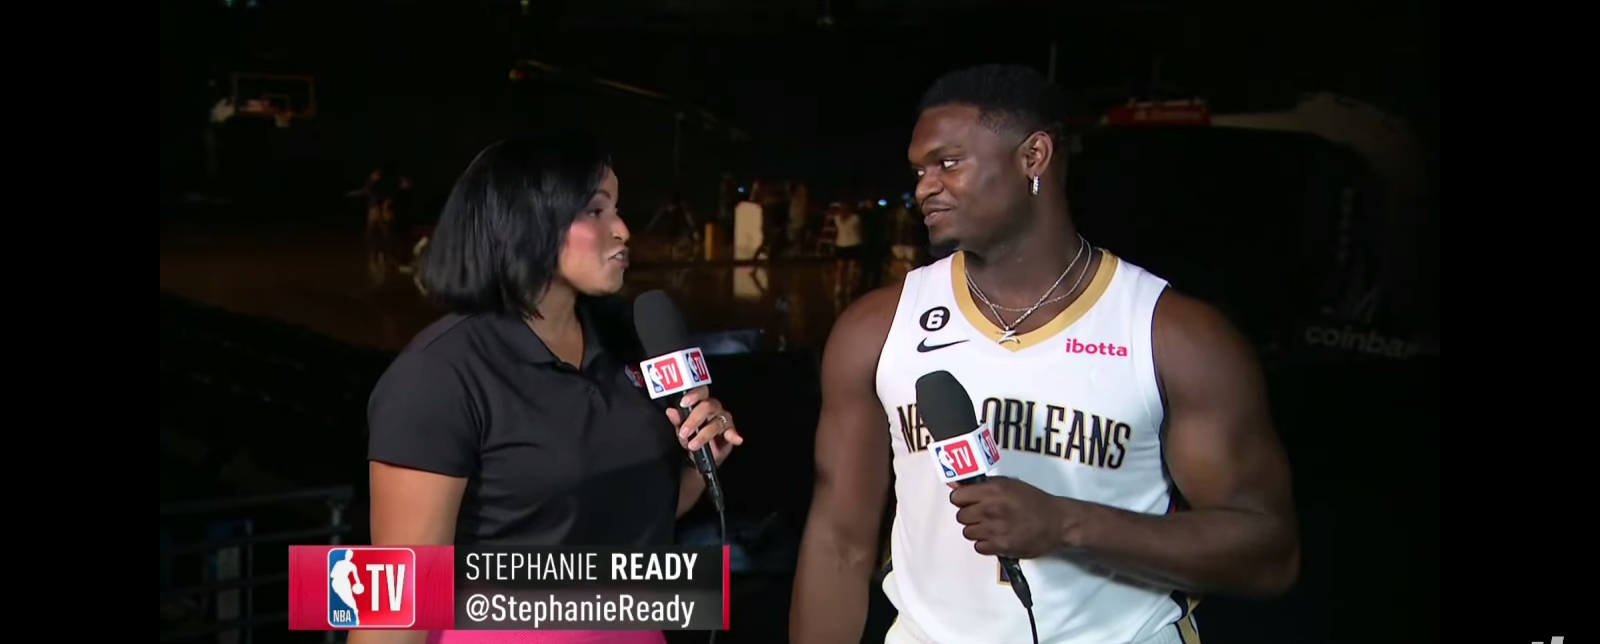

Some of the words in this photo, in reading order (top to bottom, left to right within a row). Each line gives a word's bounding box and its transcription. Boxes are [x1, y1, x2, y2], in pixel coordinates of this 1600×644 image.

[926, 309, 944, 329] 6
[1065, 338, 1128, 357] ibotta
[1304, 325, 1421, 361] coinba
[661, 363, 679, 385] TV
[980, 397, 1131, 469] ORLEANS
[951, 445, 973, 470] TV
